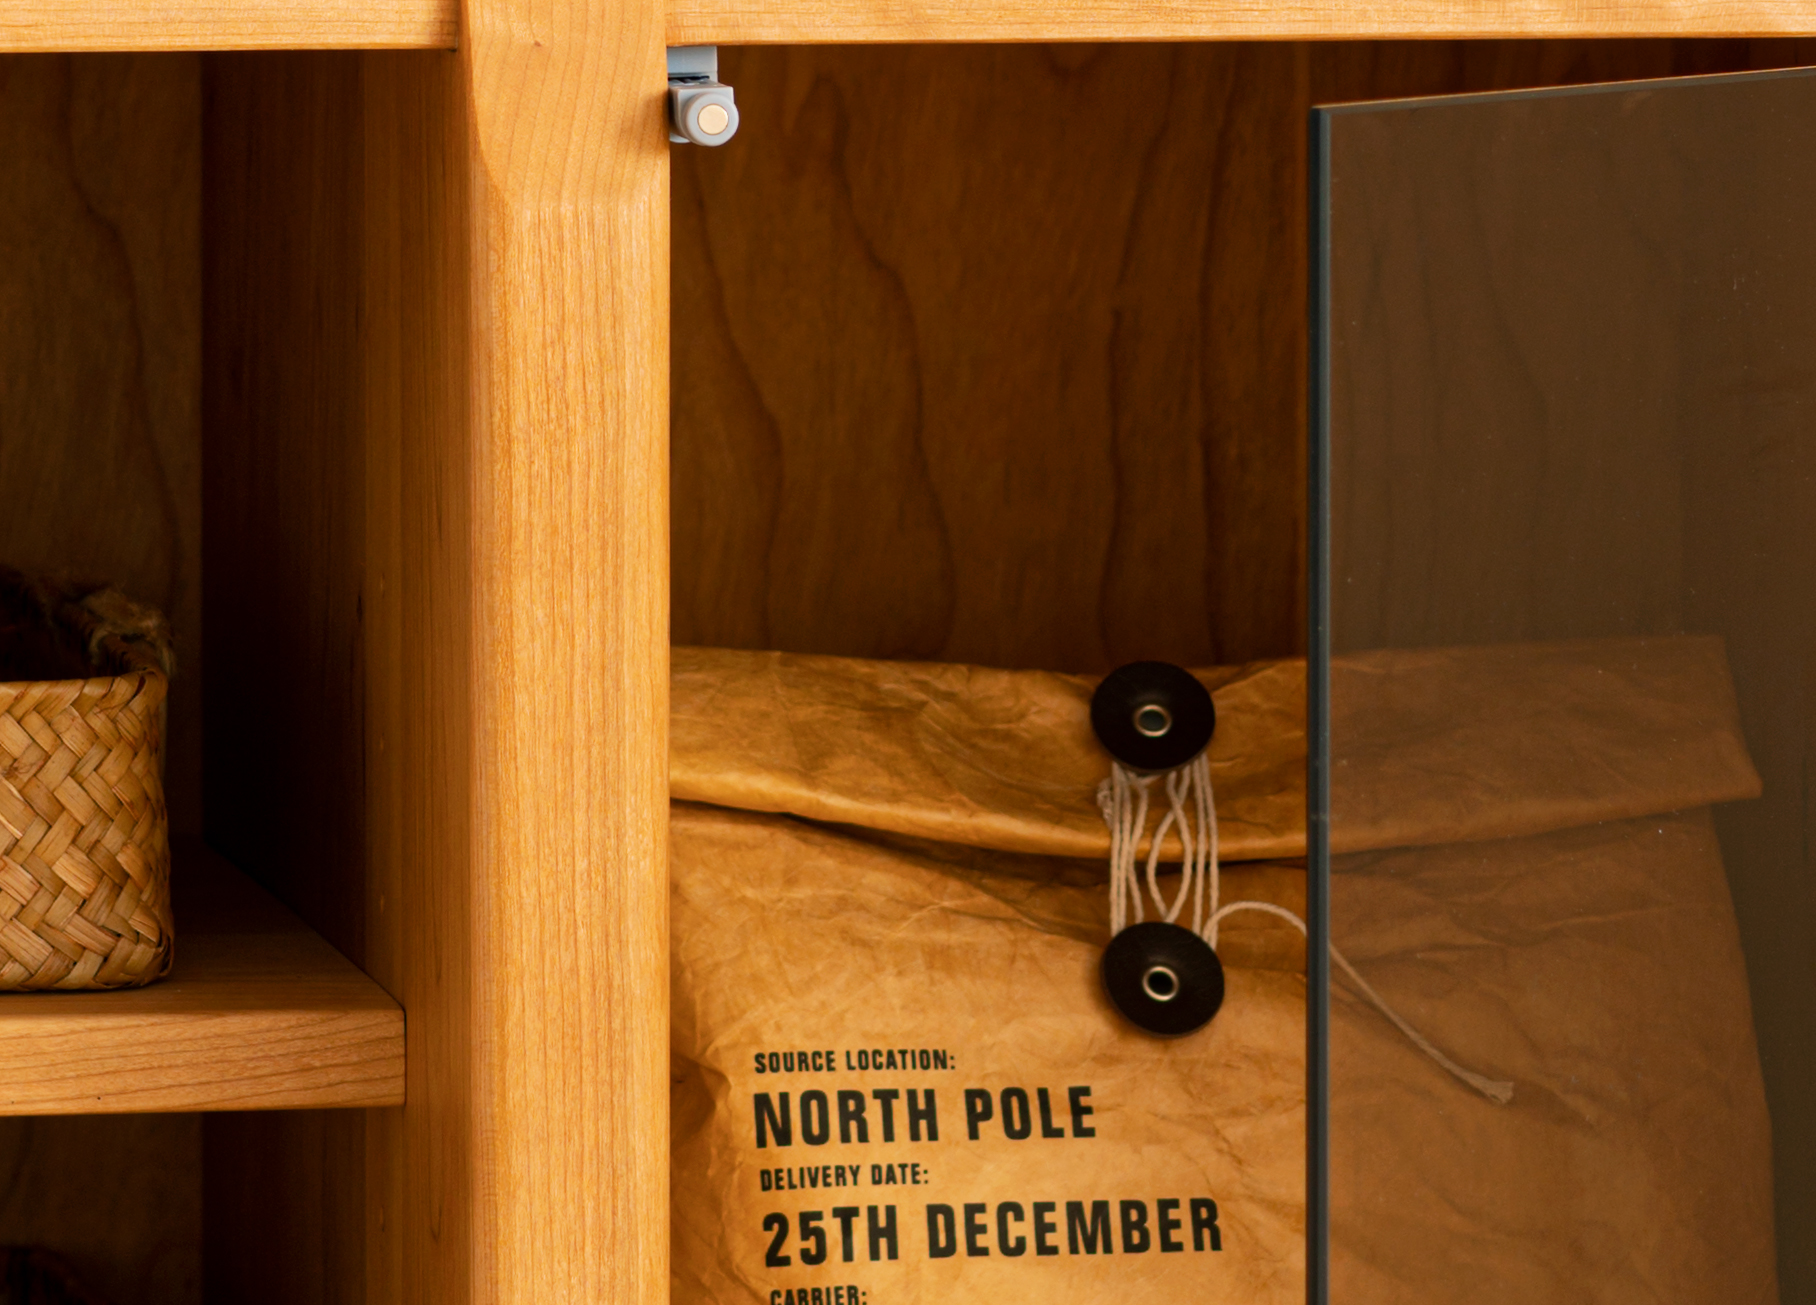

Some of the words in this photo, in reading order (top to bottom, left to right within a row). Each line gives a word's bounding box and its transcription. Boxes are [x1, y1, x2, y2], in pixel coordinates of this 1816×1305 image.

[755, 1051, 835, 1073] SOURCE
[846, 1049, 955, 1070] LOCATION:
[754, 1089, 938, 1148] NORTH
[965, 1086, 1095, 1140] POLE
[760, 1165, 860, 1192] DELIVERY
[872, 1164, 928, 1185] DATE:
[763, 1205, 898, 1268] 25TH
[927, 1198, 1222, 1258] DECEMBER
